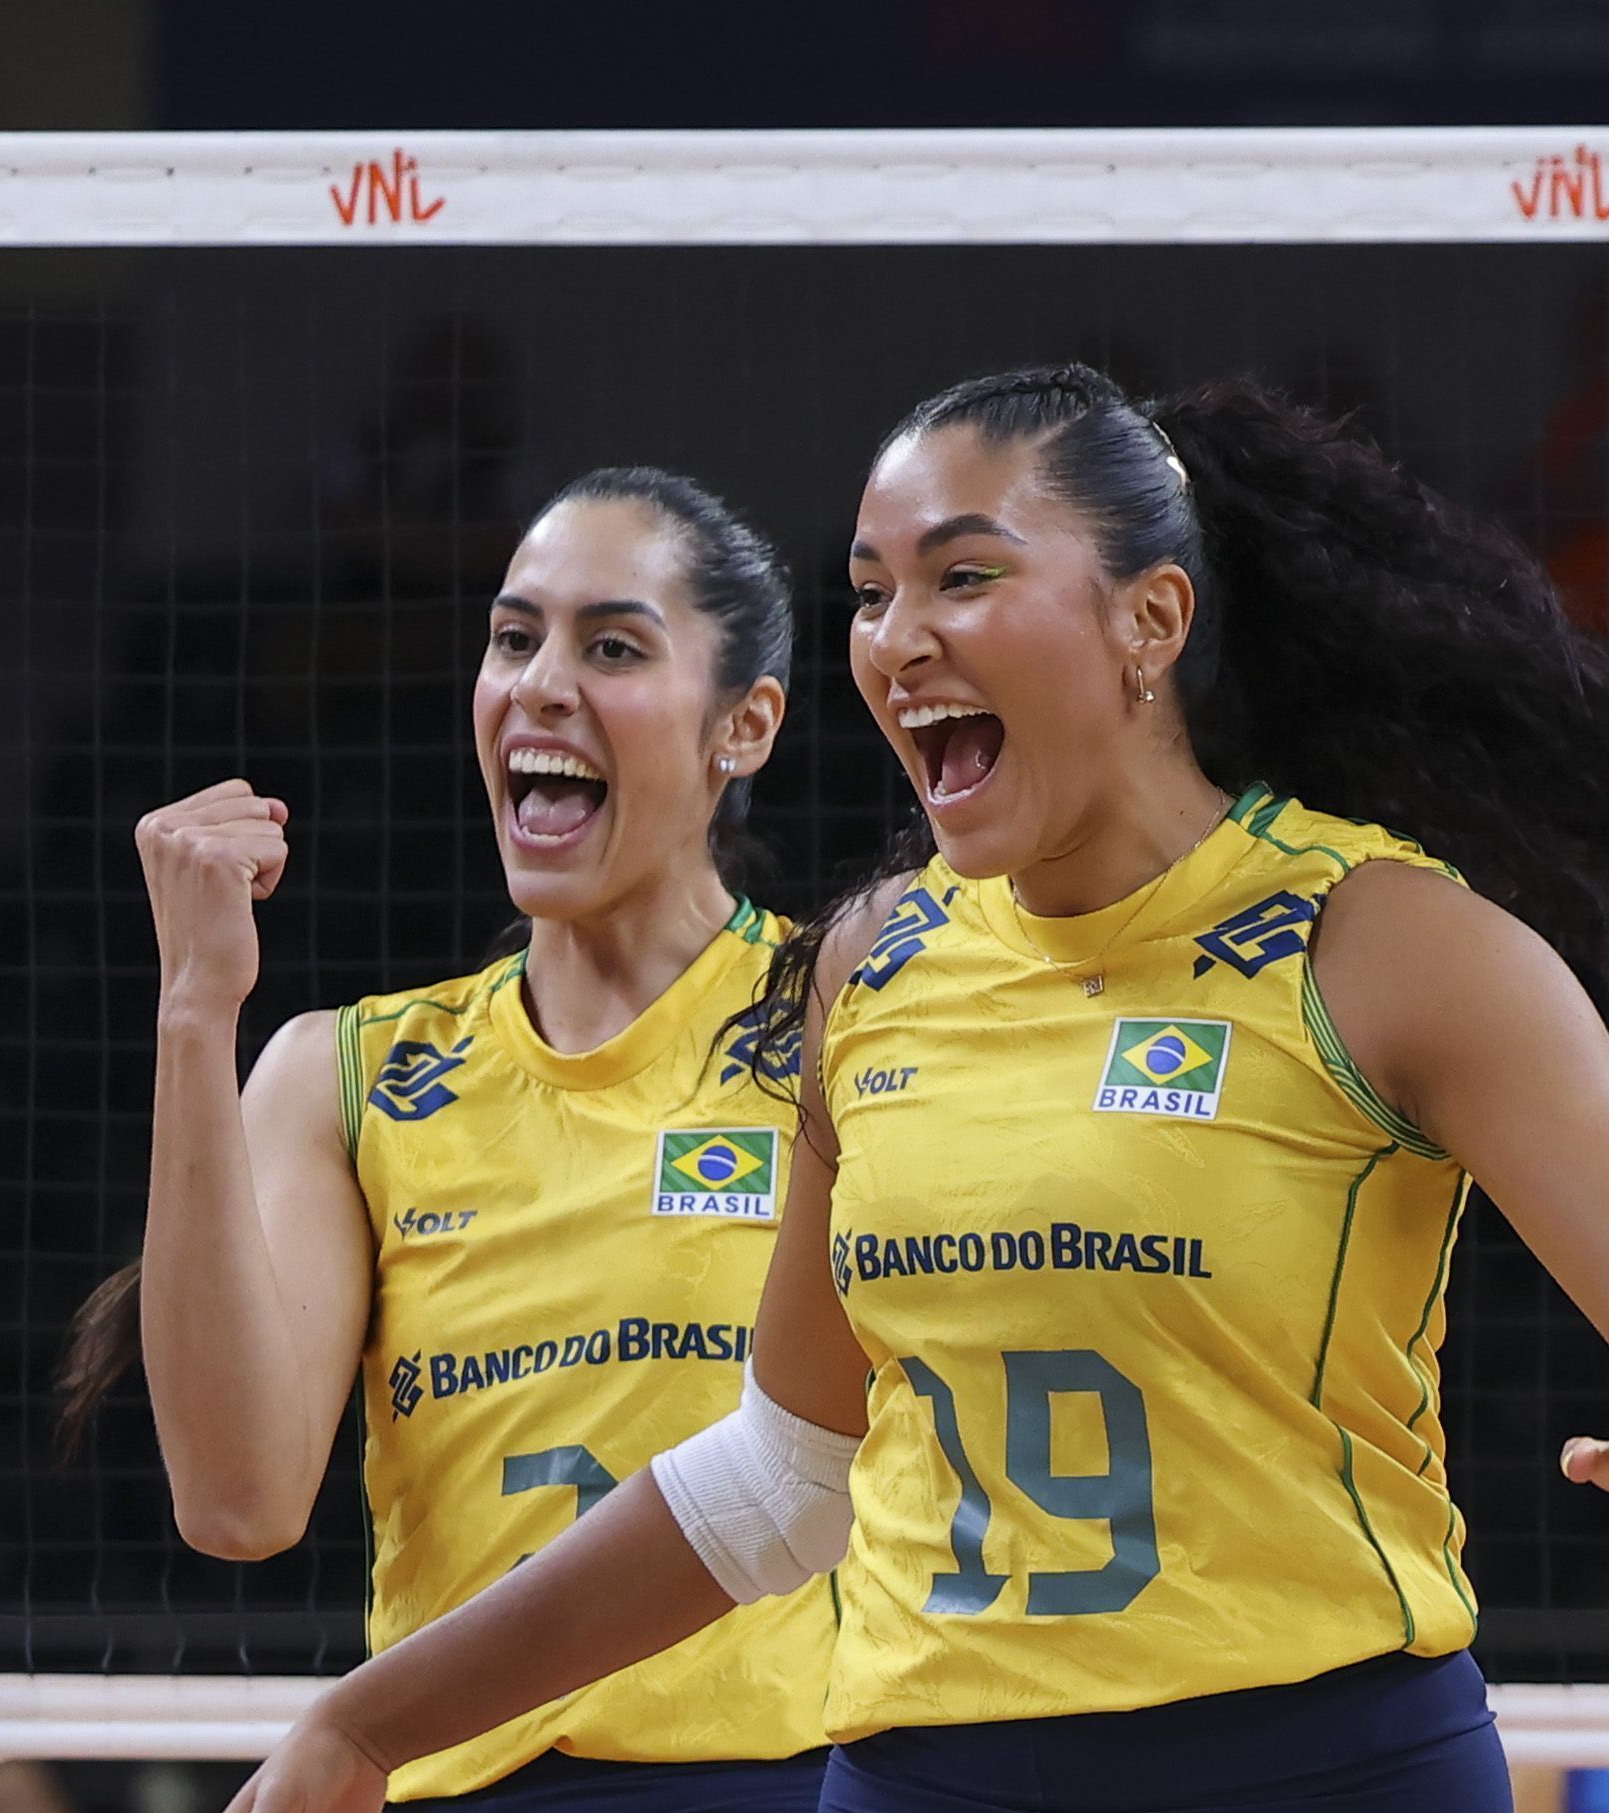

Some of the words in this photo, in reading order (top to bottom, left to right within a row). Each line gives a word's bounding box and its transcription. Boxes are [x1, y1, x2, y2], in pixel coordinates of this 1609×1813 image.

[330, 147, 445, 225] VNL
[854, 1066, 919, 1099] VOLT
[1098, 1088, 1211, 1116] BRASIL
[393, 1207, 478, 1241] VOLT
[657, 1195, 770, 1217] BRASIL
[855, 1232, 986, 1281] BANCO
[991, 1231, 1045, 1270] DO
[1050, 1223, 1212, 1280] BRASIL
[429, 1339, 558, 1400] BANCO
[558, 1330, 611, 1368] DO
[618, 1318, 754, 1363] BRASI
[900, 1349, 1160, 1616] 19
